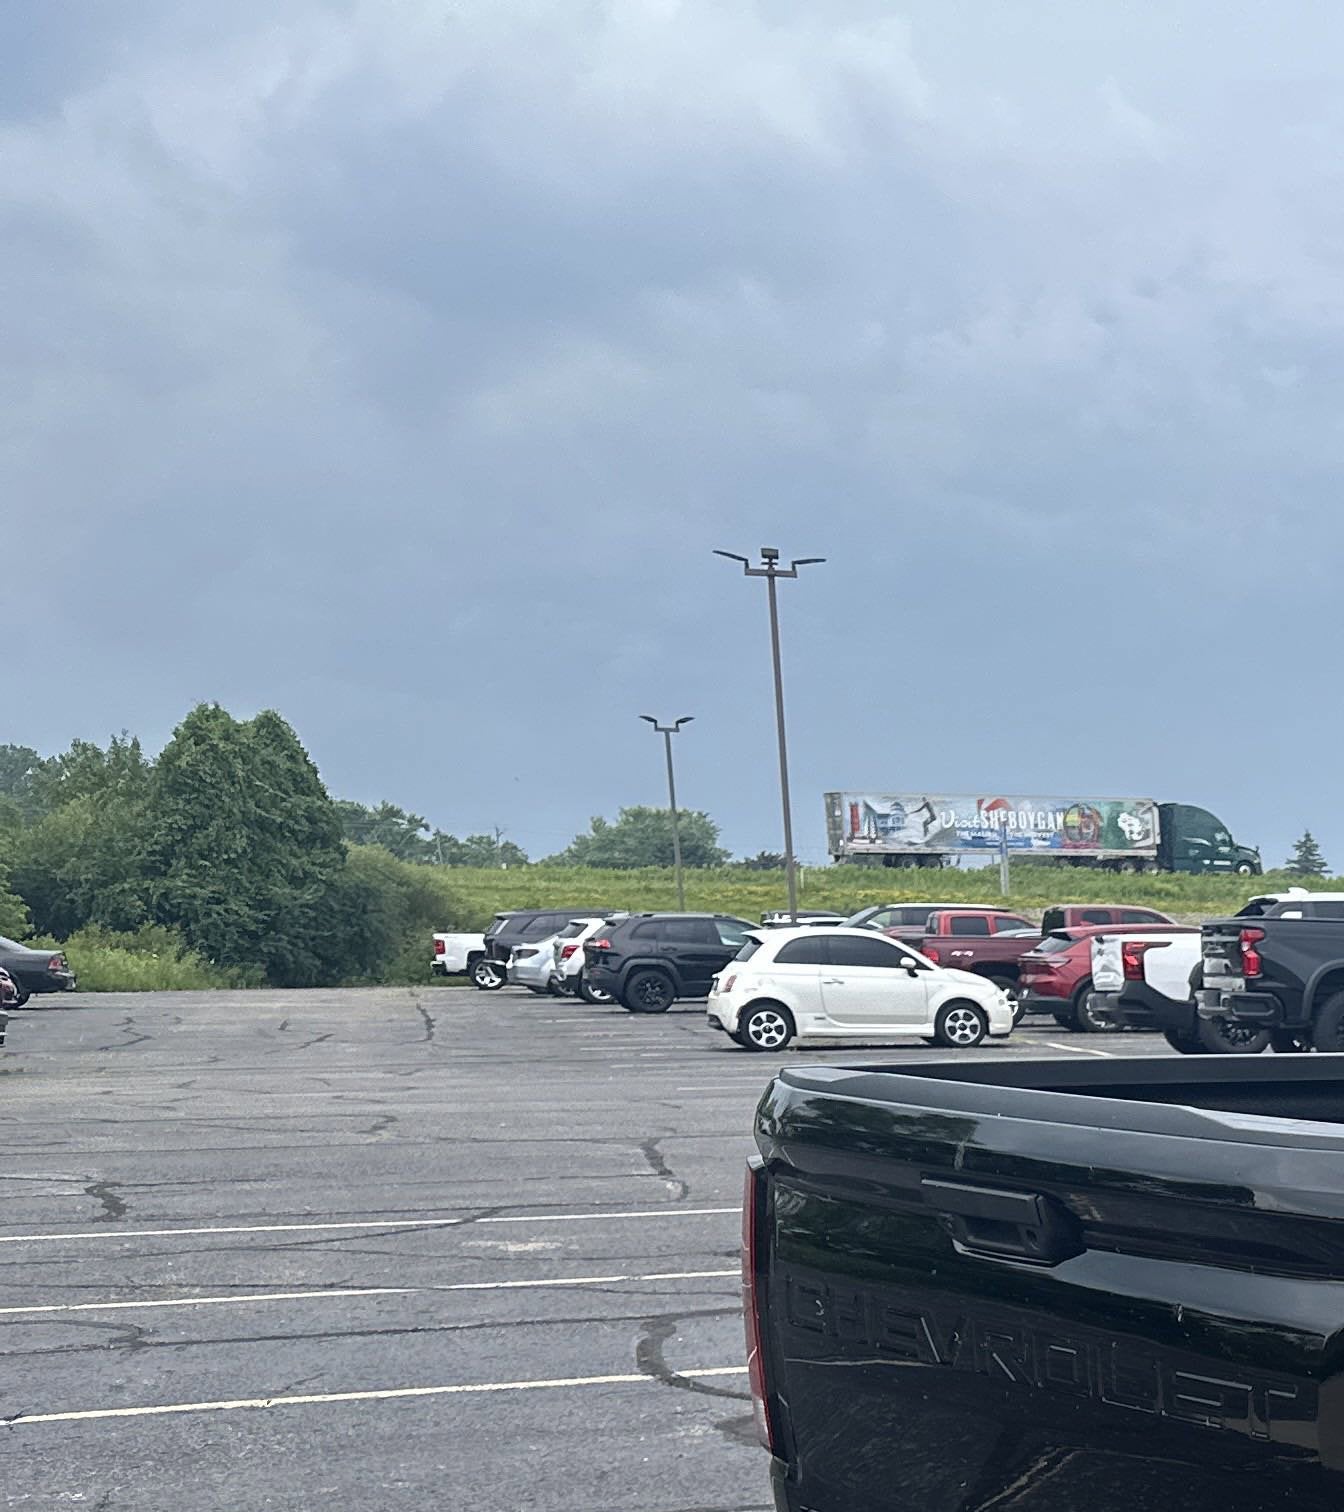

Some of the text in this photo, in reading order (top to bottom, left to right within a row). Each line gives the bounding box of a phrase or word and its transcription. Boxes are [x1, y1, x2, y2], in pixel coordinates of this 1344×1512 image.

[940, 810, 1064, 830] Visit SHEBOYGAN
[786, 1273, 1298, 1438] CHEVROLET
